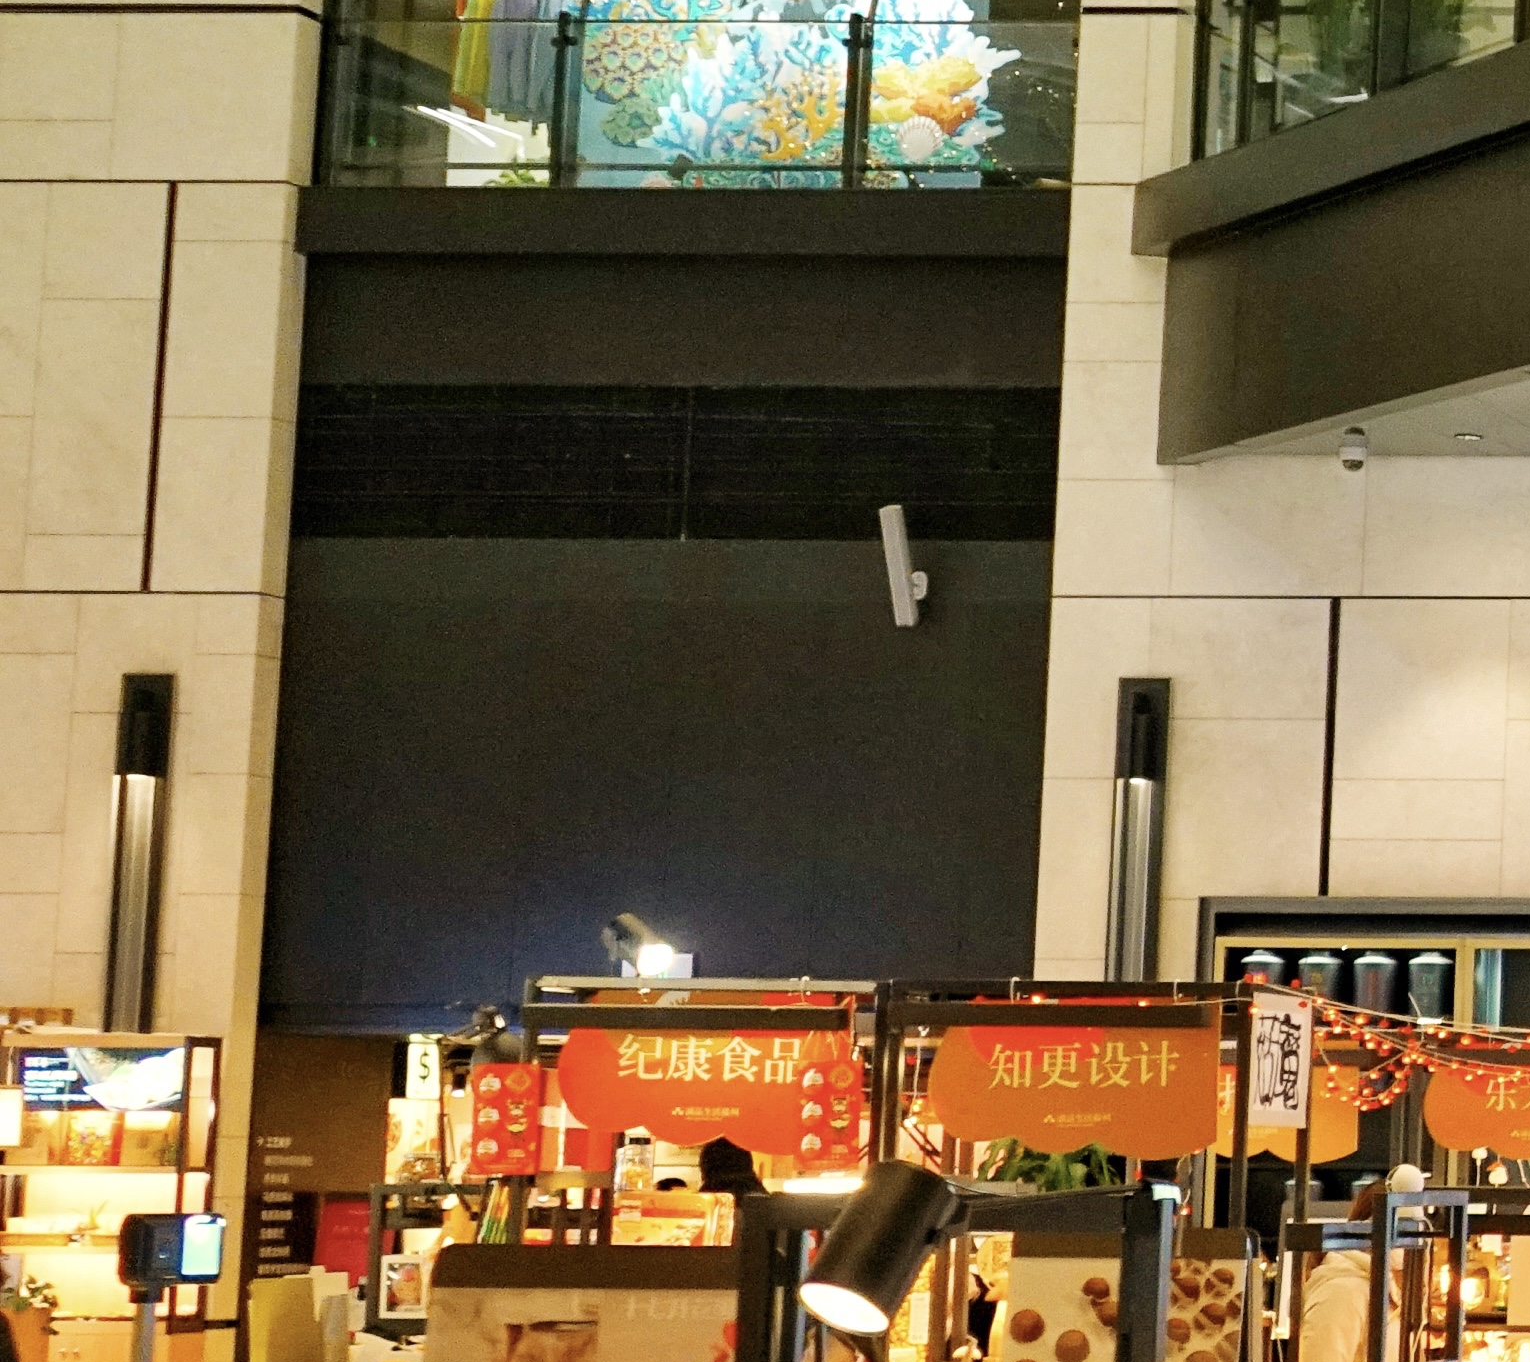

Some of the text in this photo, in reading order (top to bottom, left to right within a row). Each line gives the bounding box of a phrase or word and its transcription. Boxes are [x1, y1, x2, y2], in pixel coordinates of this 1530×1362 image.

[617, 1033, 801, 1084] 纪康食品
[987, 1039, 1180, 1090] 知更设计
